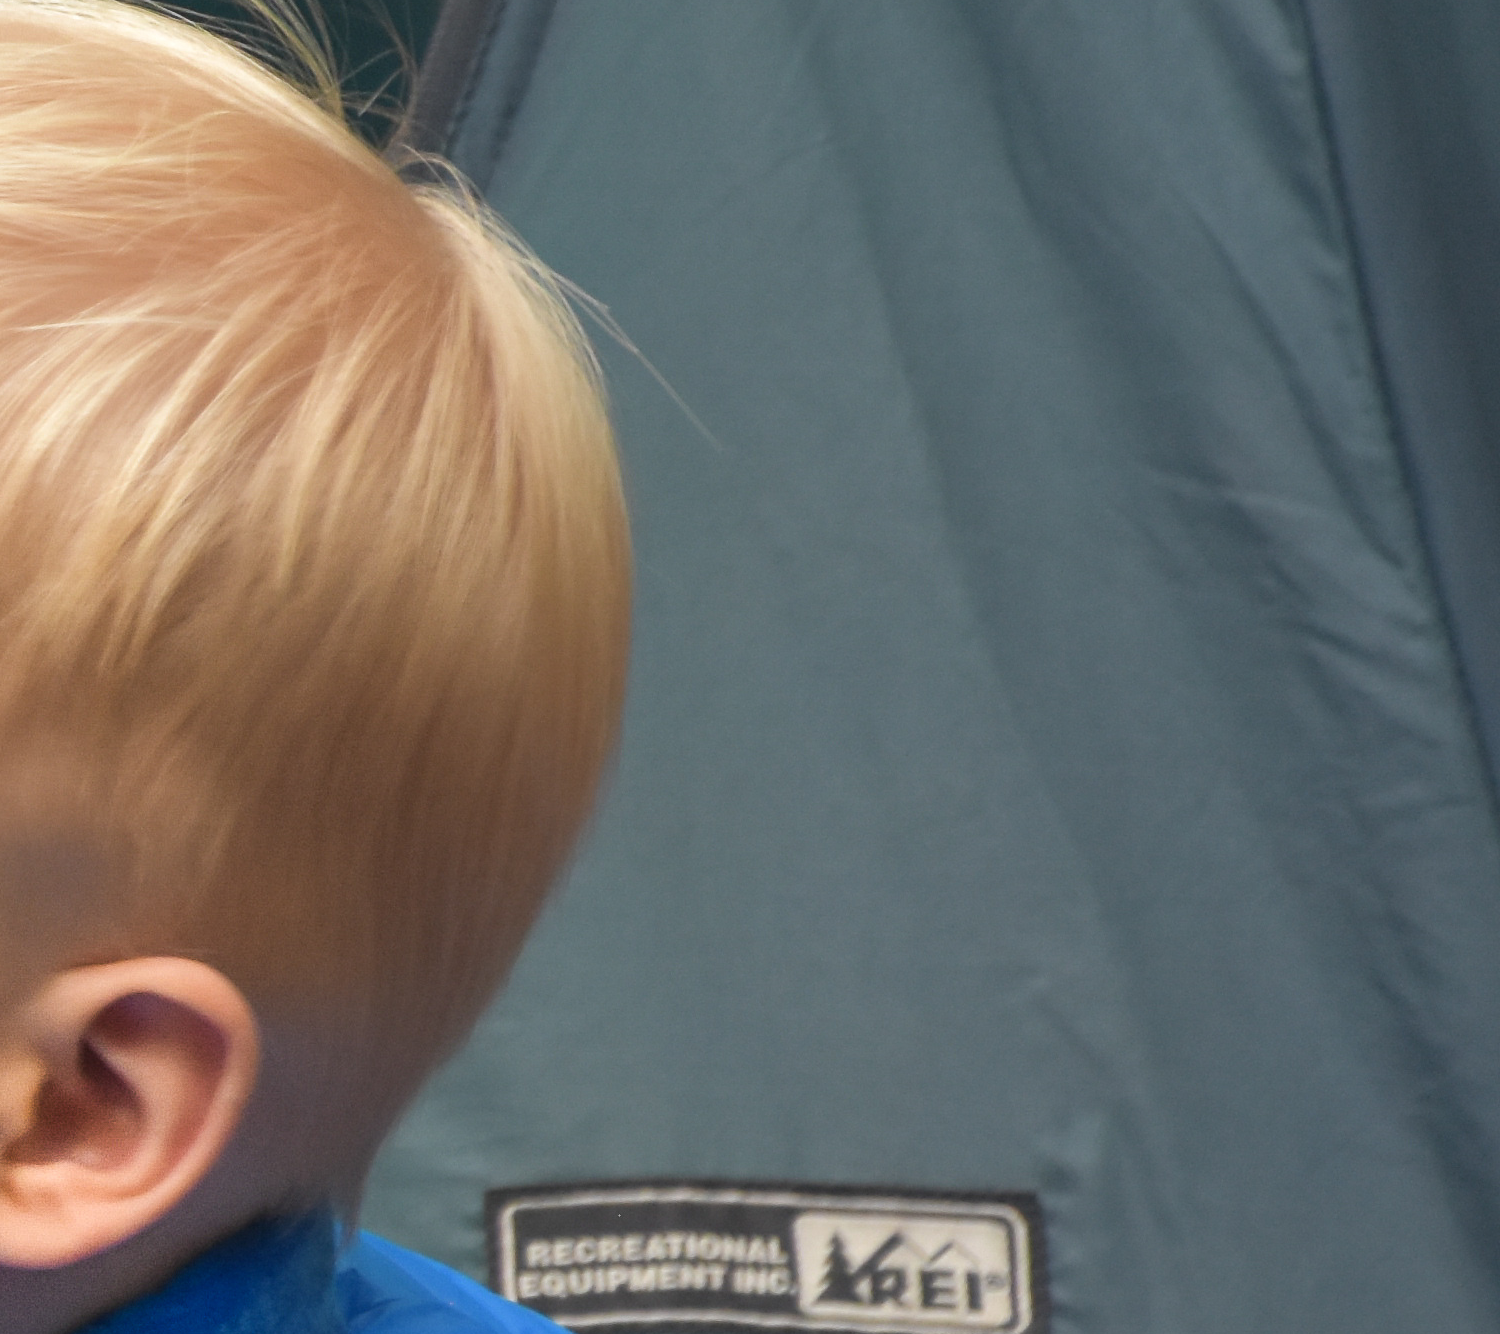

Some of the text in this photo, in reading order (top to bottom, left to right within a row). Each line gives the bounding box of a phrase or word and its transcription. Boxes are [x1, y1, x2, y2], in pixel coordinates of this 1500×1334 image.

[526, 1231, 788, 1267] RECREATIONAL
[518, 1262, 796, 1299] EQUIPMENT INC.
